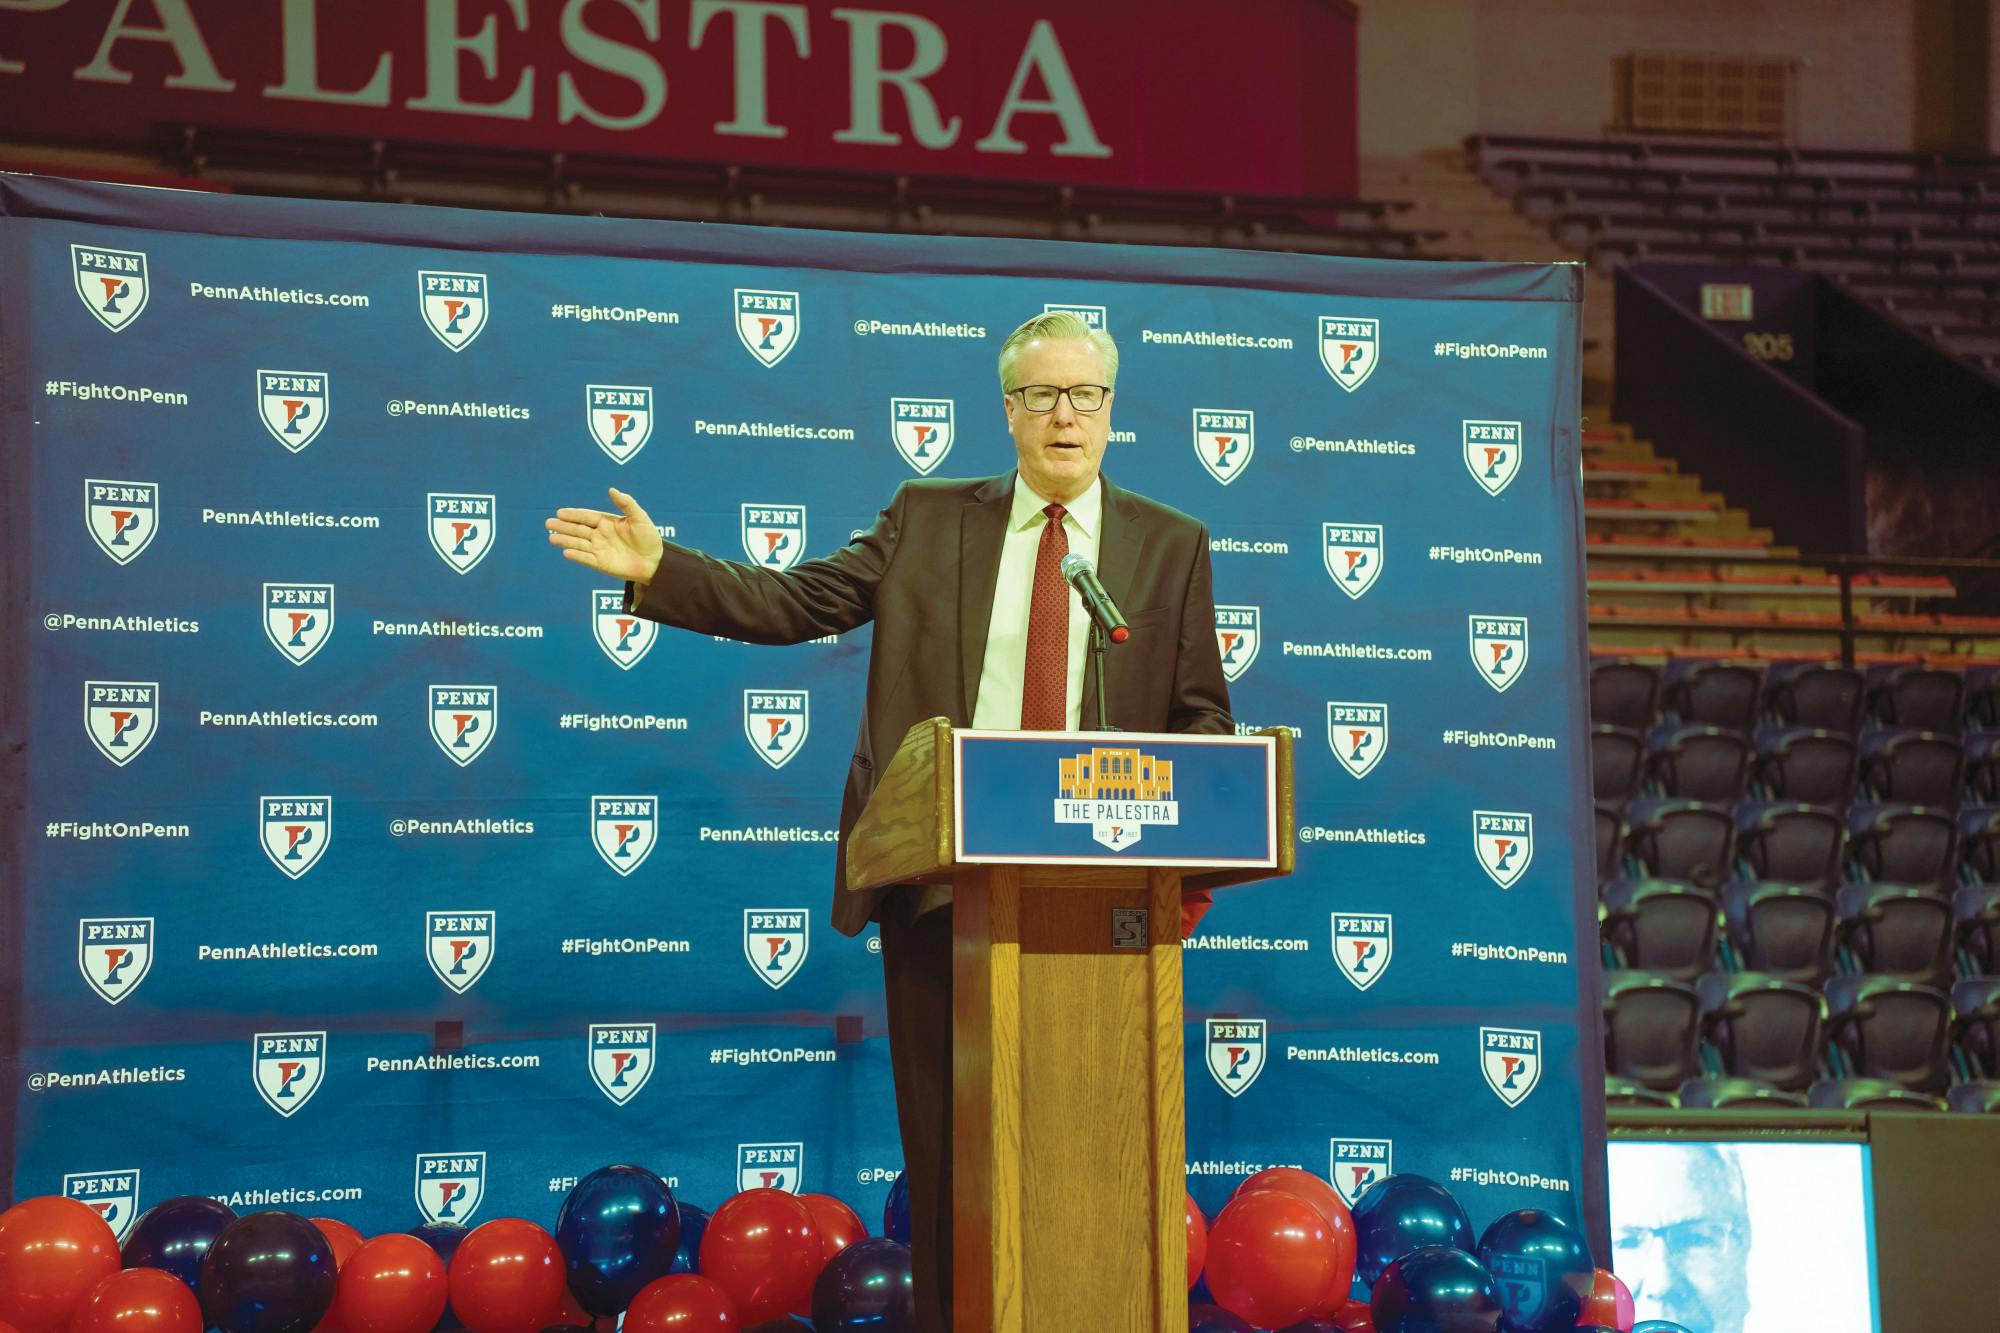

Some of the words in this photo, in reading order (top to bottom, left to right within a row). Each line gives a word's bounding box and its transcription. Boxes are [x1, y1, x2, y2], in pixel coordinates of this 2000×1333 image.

[80, 251, 139, 272] PENN
[426, 277, 480, 293] PENN
[190, 282, 370, 307] PennAthletics.com
[741, 295, 793, 311] PENN
[551, 303, 679, 324] #FightOnPenn
[853, 319, 986, 338] @PennAthletics
[1325, 322, 1373, 337] PENN
[1142, 329, 1294, 350] PennAthletics.com
[1433, 342, 1548, 360] #FightOnPenn
[45, 380, 188, 406] #FightOnPenn
[265, 376, 321, 393] PENN
[593, 391, 646, 406] PENN
[386, 399, 530, 420] @PennAthletics
[897, 403, 948, 419] PENN
[694, 420, 855, 441] PennAthletics.com
[1199, 414, 1248, 430] PENN
[1469, 425, 1516, 440] PENN
[1289, 436, 1416, 455] @PennAthletics
[93, 486, 151, 503] PENN
[435, 499, 489, 515] PENN
[202, 508, 380, 528] PennAthletics.com
[748, 509, 799, 525] PENN
[1329, 528, 1377, 544] PENN
[1208, 537, 1289, 554] letics.com
[1428, 546, 1542, 565] #FightOnPenn
[271, 589, 327, 604] PENN
[599, 596, 623, 611] PE
[43, 613, 200, 633] @PennAthletics
[1215, 611, 1254, 625] ENN
[373, 620, 544, 638] PennAthletics.com
[1475, 621, 1522, 636] PENN
[1282, 641, 1433, 661] PennAthletics.com
[92, 687, 152, 703] PENN
[436, 691, 491, 706] PENN
[751, 695, 802, 710] PENN
[200, 710, 378, 727] PennAthletics.com
[559, 713, 688, 732] #FightOnPenn
[1334, 707, 1382, 723] PENN
[1442, 729, 1556, 750] #FightOnPenn
[268, 802, 324, 817] PENN
[598, 801, 651, 816] PENN
[1063, 803, 1090, 820] THE
[1097, 804, 1170, 821] PALESTRA
[45, 822, 190, 841] #FightOnPenn
[389, 818, 534, 837] @PennAthletics
[1479, 816, 1527, 833] PENN
[1299, 828, 1425, 846] @PennAthletics
[433, 917, 488, 932] PENN
[751, 915, 802, 929] PENN
[1338, 918, 1386, 933] PENN
[87, 924, 147, 940] PENN
[198, 942, 378, 961] PennAthletics.com
[561, 937, 690, 956] #FightOnPenn
[1451, 942, 1568, 964] #FightOnPenn
[596, 1029, 649, 1044] PENN
[1213, 1025, 1260, 1039] PENN
[261, 1038, 319, 1054] PENN
[1487, 1033, 1535, 1050] PENN
[367, 1053, 540, 1072] PennAthletics.com
[709, 1047, 837, 1066] #FightOnPenn
[1287, 1045, 1440, 1065] PennAthletics.com
[27, 1066, 186, 1092] @PennAthletics
[745, 1149, 796, 1164] PENN
[1337, 1144, 1386, 1159] PENN
[423, 1158, 479, 1174] PENN
[71, 1176, 132, 1195] PENN
[1450, 1167, 1570, 1192] #FightOnPenn
